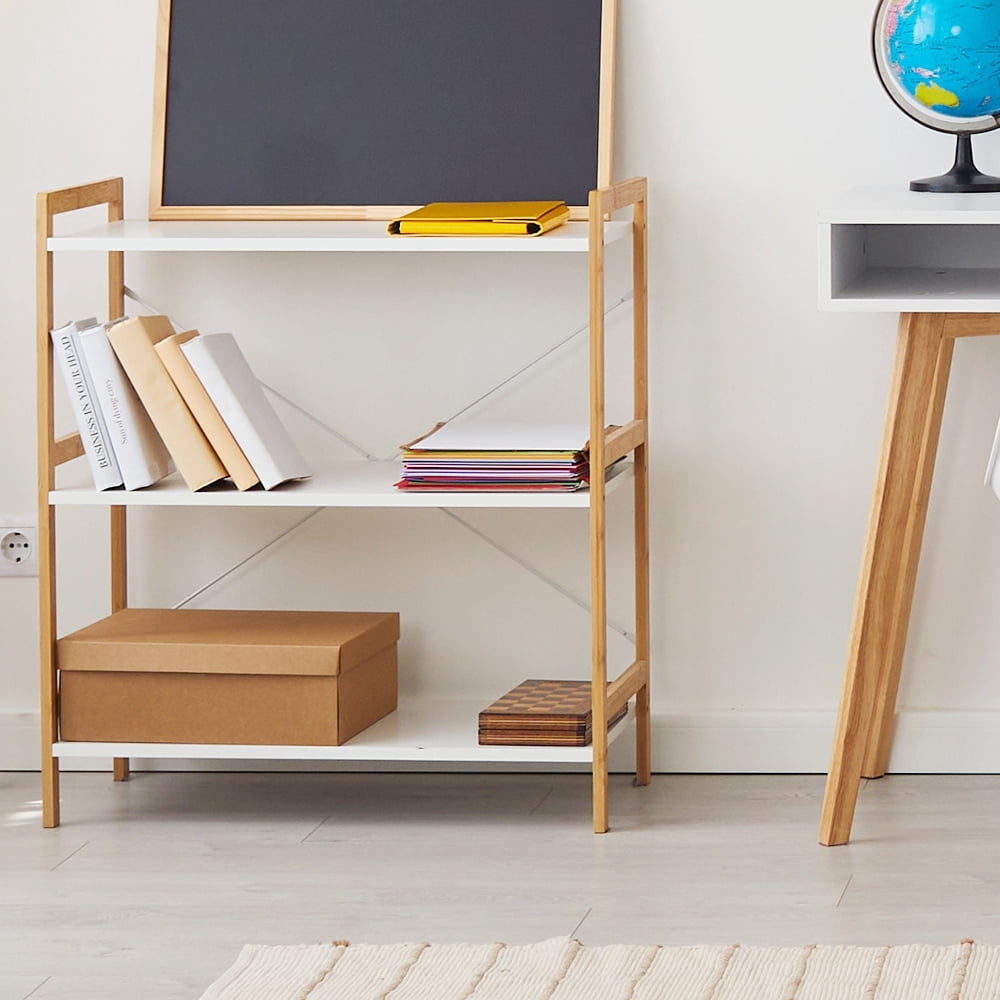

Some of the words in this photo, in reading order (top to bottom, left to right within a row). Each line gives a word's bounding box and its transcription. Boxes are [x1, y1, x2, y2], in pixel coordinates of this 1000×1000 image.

[61, 336, 78, 368] HEAD
[71, 369, 88, 401] YOUR
[82, 403, 92, 415] IN
[87, 417, 108, 469] BUSINESS
